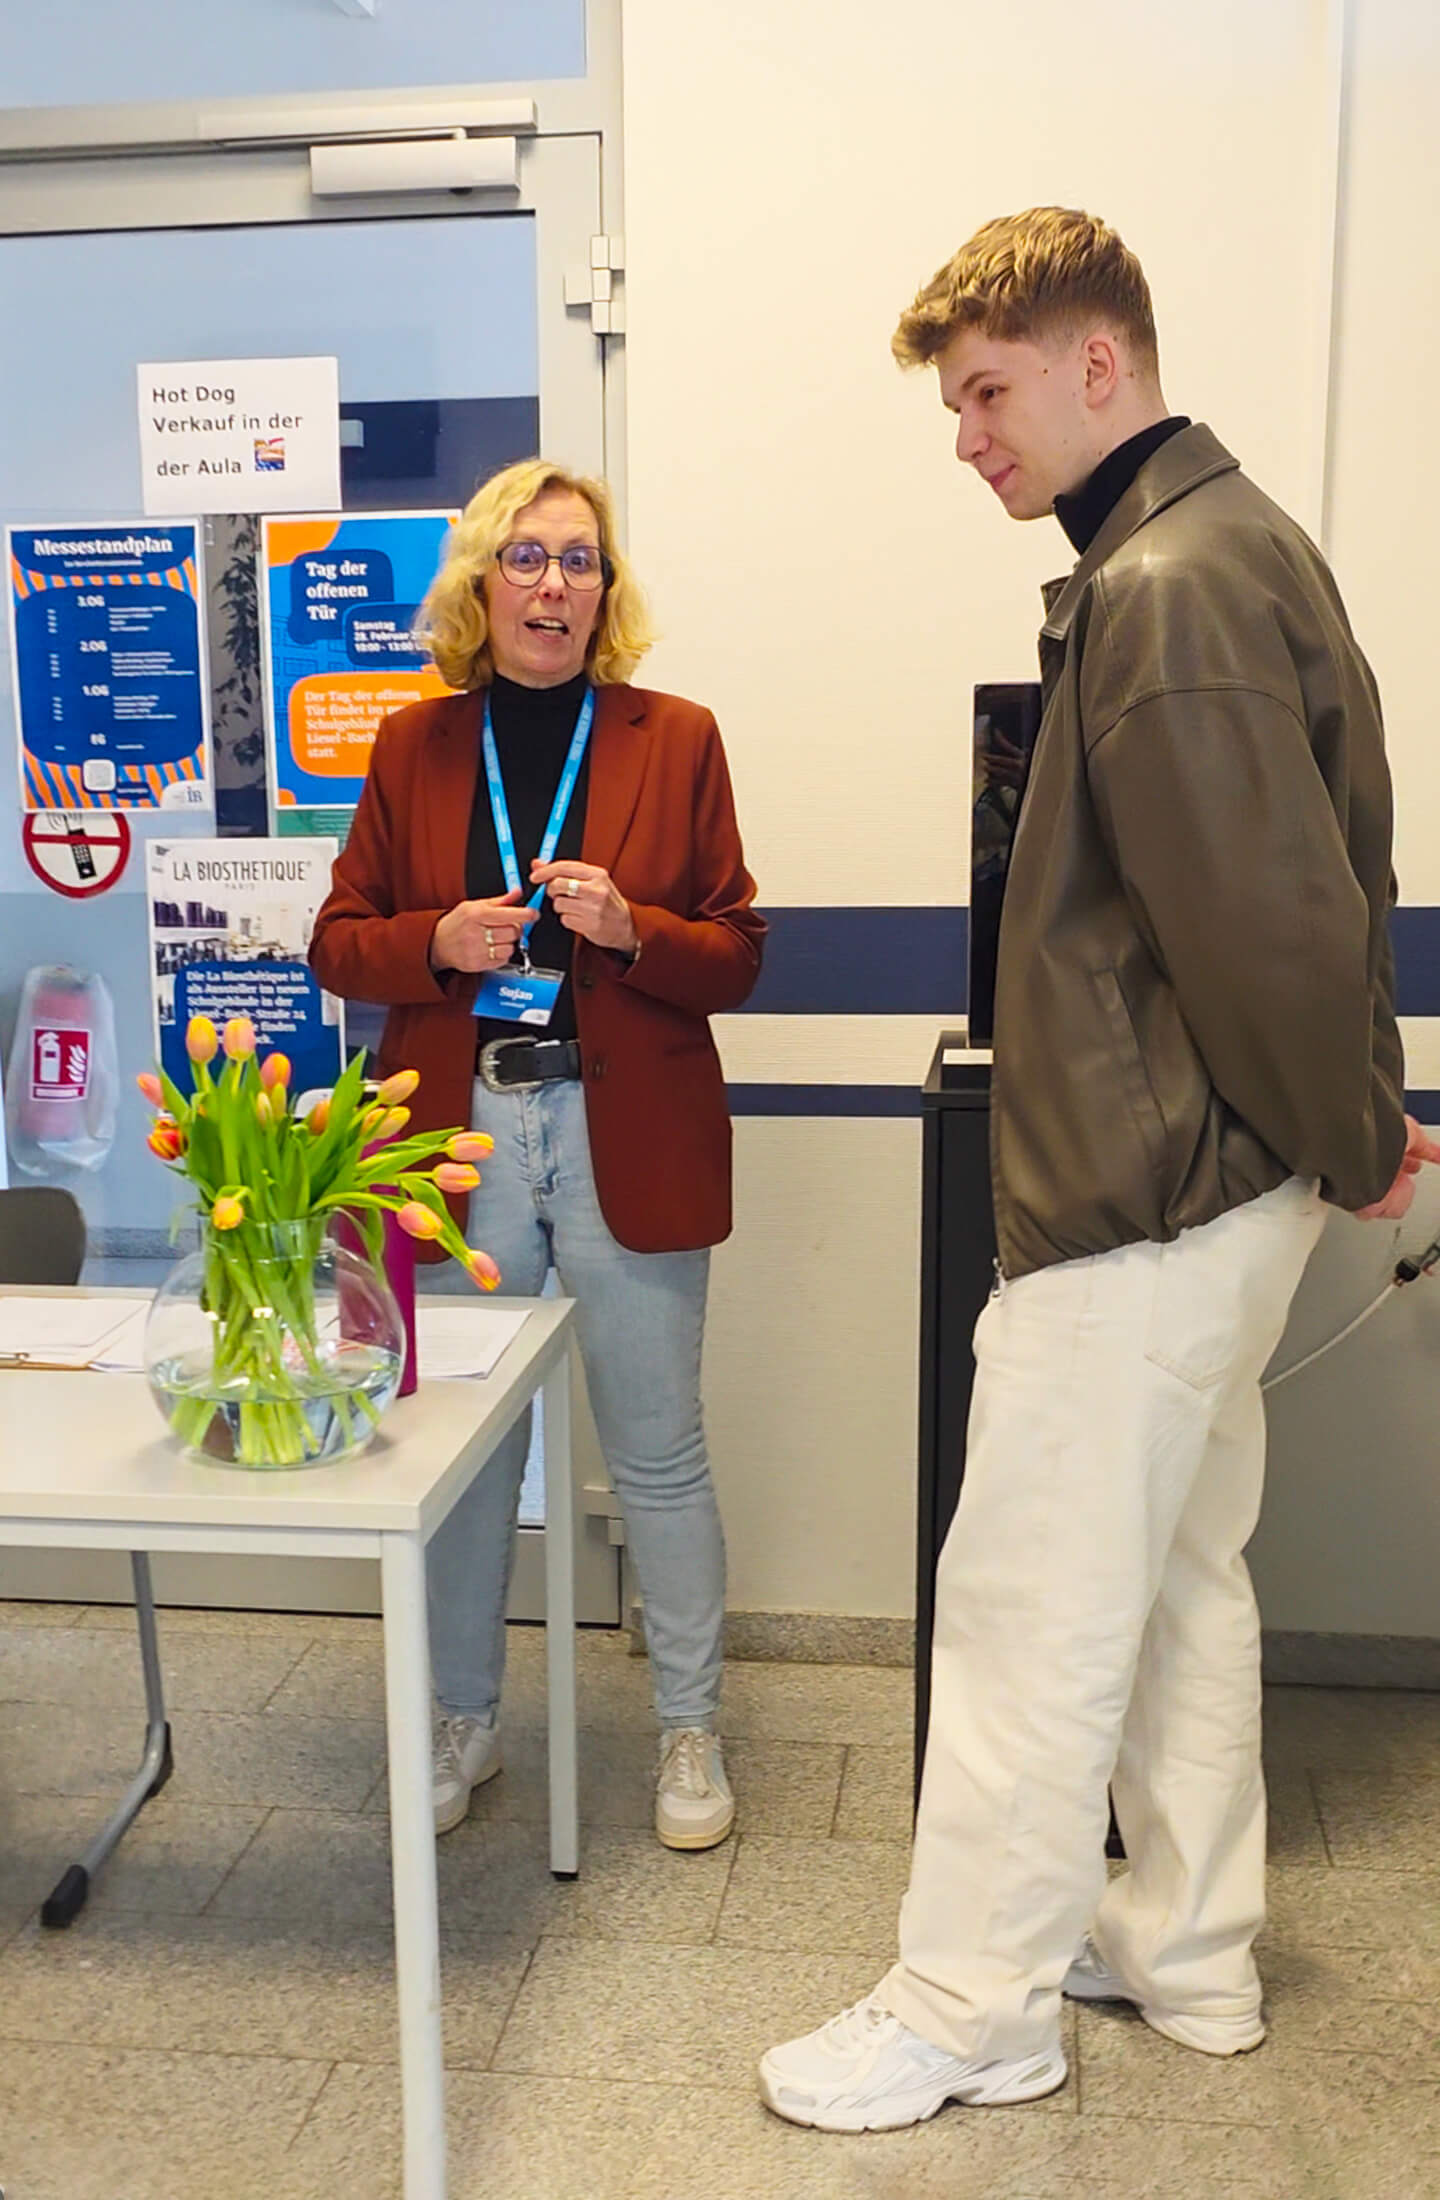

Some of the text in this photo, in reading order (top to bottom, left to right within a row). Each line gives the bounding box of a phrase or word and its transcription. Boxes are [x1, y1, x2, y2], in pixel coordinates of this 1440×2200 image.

[152, 386, 235, 404] Hot Dog
[153, 414, 303, 433] Verkauf in der
[157, 459, 242, 476] der Aula
[33, 536, 173, 557] Messestandplan
[305, 561, 368, 579] Tag der
[306, 583, 368, 598] offenen
[307, 606, 337, 620] Tür
[353, 621, 395, 631] Samstag
[305, 691, 325, 701] Der
[328, 691, 351, 703] Tag
[353, 691, 372, 701] der
[305, 705, 326, 715] Tür
[329, 704, 364, 714] findet
[367, 705, 384, 714] im
[307, 748, 337, 758] statt.
[173, 862, 191, 881] LA
[186, 971, 204, 981] Die
[206, 971, 220, 981] La
[290, 971, 305, 981] ist
[275, 998, 293, 1006] der
